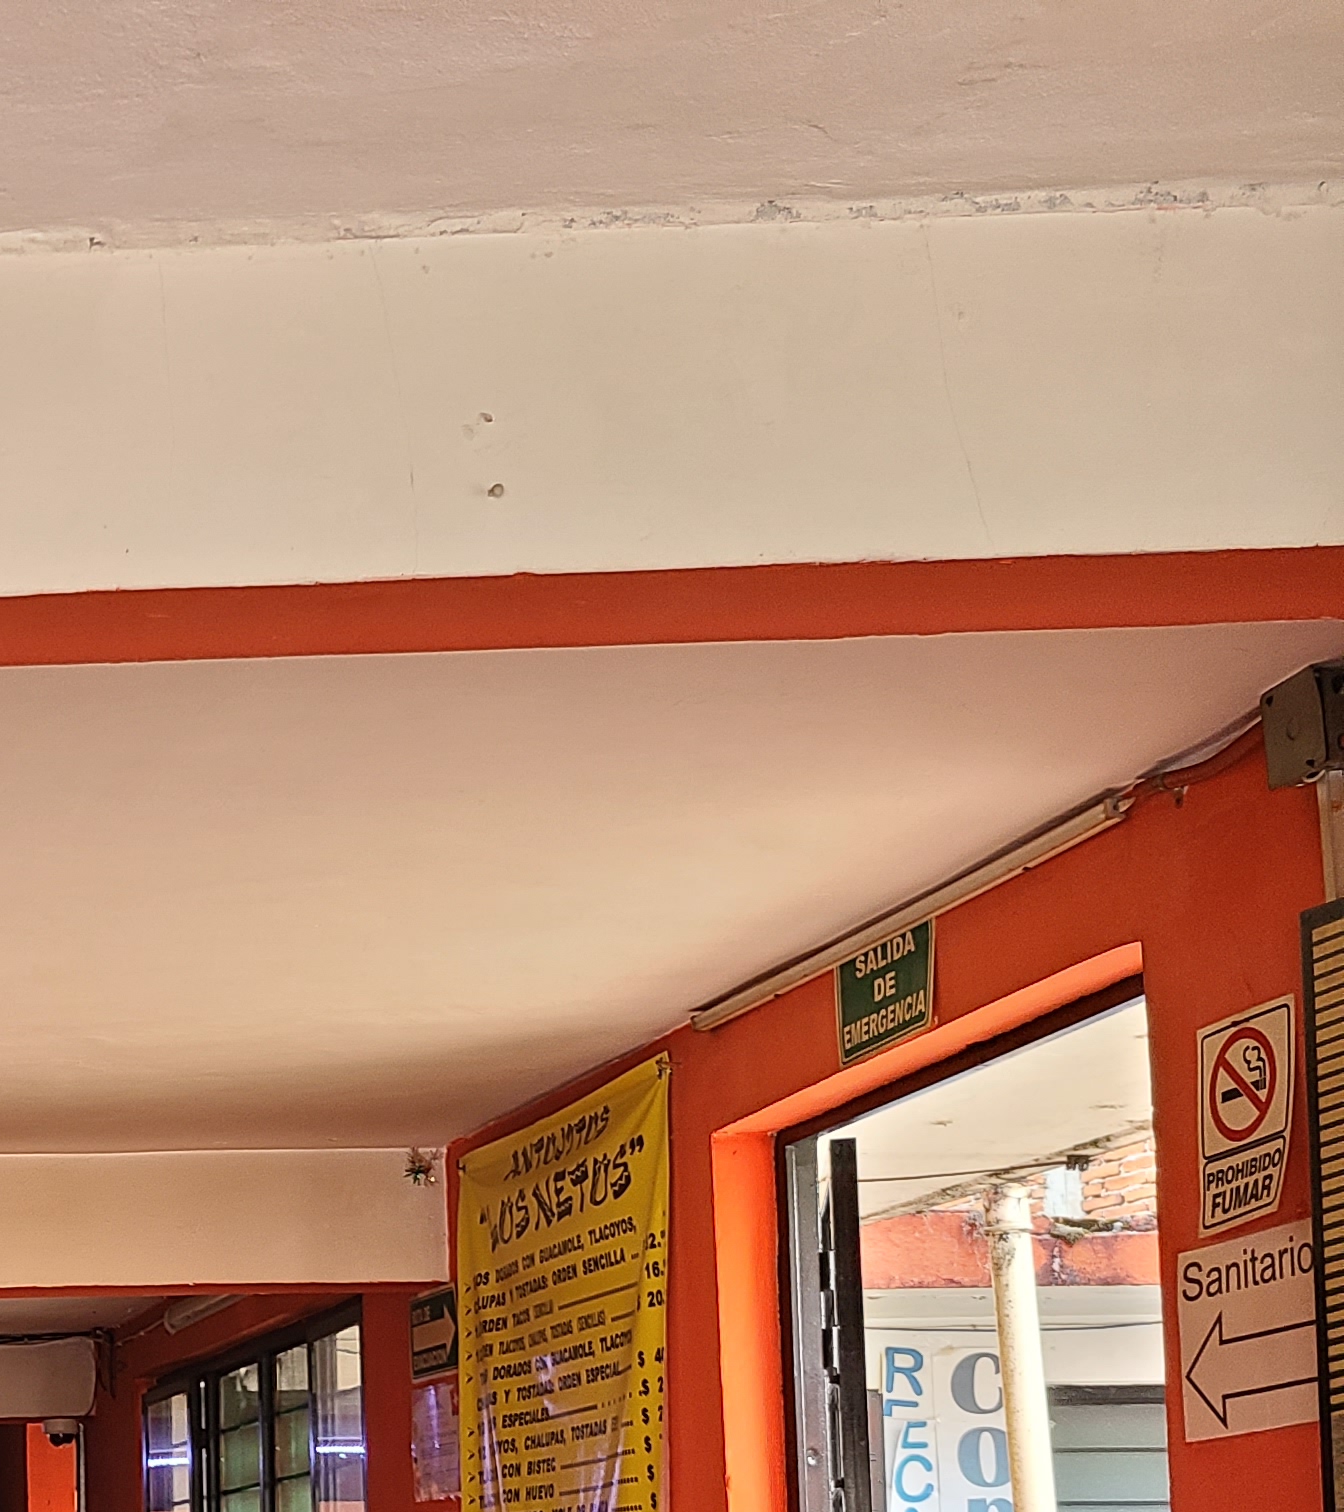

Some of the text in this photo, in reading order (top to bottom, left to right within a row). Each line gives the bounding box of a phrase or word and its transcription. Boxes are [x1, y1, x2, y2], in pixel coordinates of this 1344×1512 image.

[855, 930, 915, 979] SALIDA
[873, 971, 896, 1002] DE
[843, 989, 926, 1050] EMERGENCIA
[1206, 1148, 1282, 1191] PROHIBIDO
[1211, 1173, 1274, 1219] FUMAR
[521, 1253, 536, 1270] CON
[551, 1263, 578, 1286] ORDEN
[582, 1247, 626, 1276] SENCILLA
[1182, 1235, 1314, 1302] Sanitario
[492, 1360, 532, 1381] DORADOS
[504, 1389, 511, 1404] Y
[585, 1361, 621, 1384] ESPECIAL
[502, 1407, 551, 1429] ESPECIALES
[524, 1429, 566, 1451] CHALUPAS,
[571, 1419, 607, 1442] TOSTADAS
[501, 1463, 521, 1479] CON
[527, 1457, 556, 1473] BISTEC
[502, 1489, 520, 1504] CON
[525, 1483, 555, 1501] HUEVO
